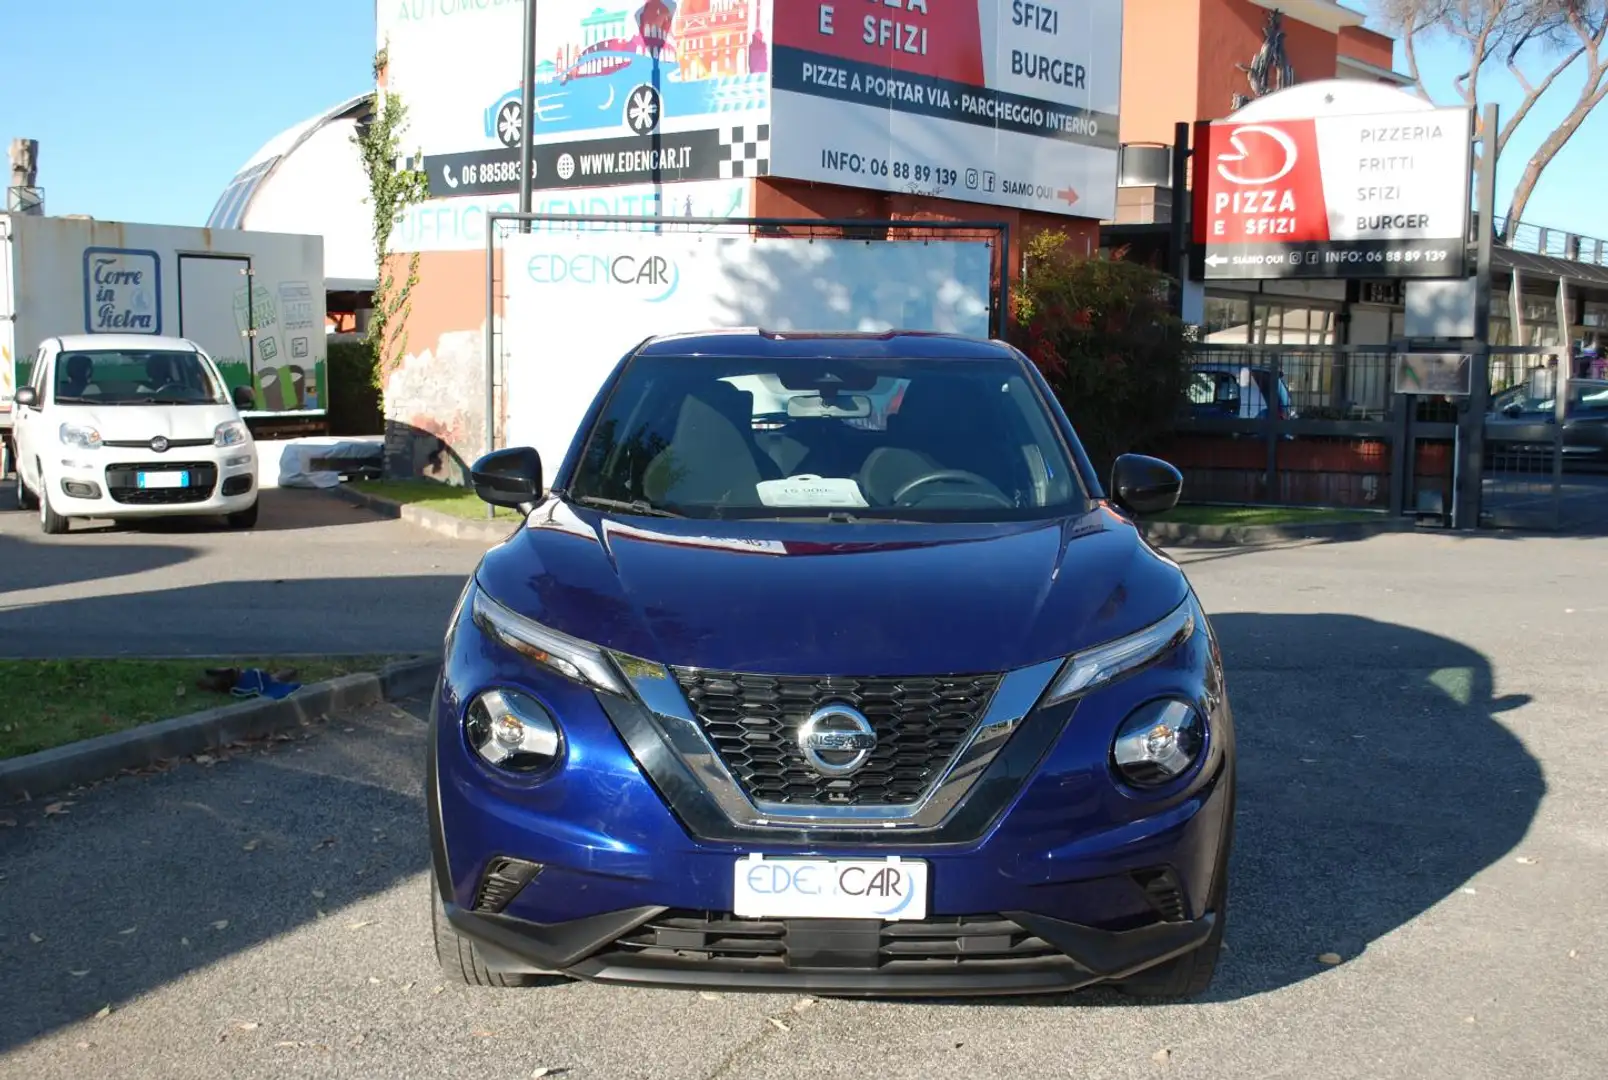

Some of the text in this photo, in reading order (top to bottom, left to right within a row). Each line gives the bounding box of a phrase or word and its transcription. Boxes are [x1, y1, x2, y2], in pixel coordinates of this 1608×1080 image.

[1012, 0, 1058, 35] SFIZI
[819, 4, 834, 35] E
[862, 14, 928, 55] SFIZI
[1011, 49, 1085, 90] BURGER
[802, 62, 1098, 138] PIZZE A PORTAR VIA PARCHEGGIO INTERNO
[1360, 125, 1443, 144] PIZZERIA
[580, 146, 692, 176] WWW.EDENCAR.IT
[821, 149, 957, 186] INFO: 06 88 89 139
[1358, 155, 1414, 172] FRITTI
[462, 164, 477, 185] 06
[1002, 180, 1053, 200] SIAMO QUI
[1357, 185, 1401, 201] SFIZI
[1215, 189, 1296, 214] PIZZA
[1213, 217, 1296, 235] E SFIZI
[1357, 213, 1430, 231] BURGER
[1325, 250, 1447, 263] INFO: 06 88 89 139
[96, 285, 115, 302] in
